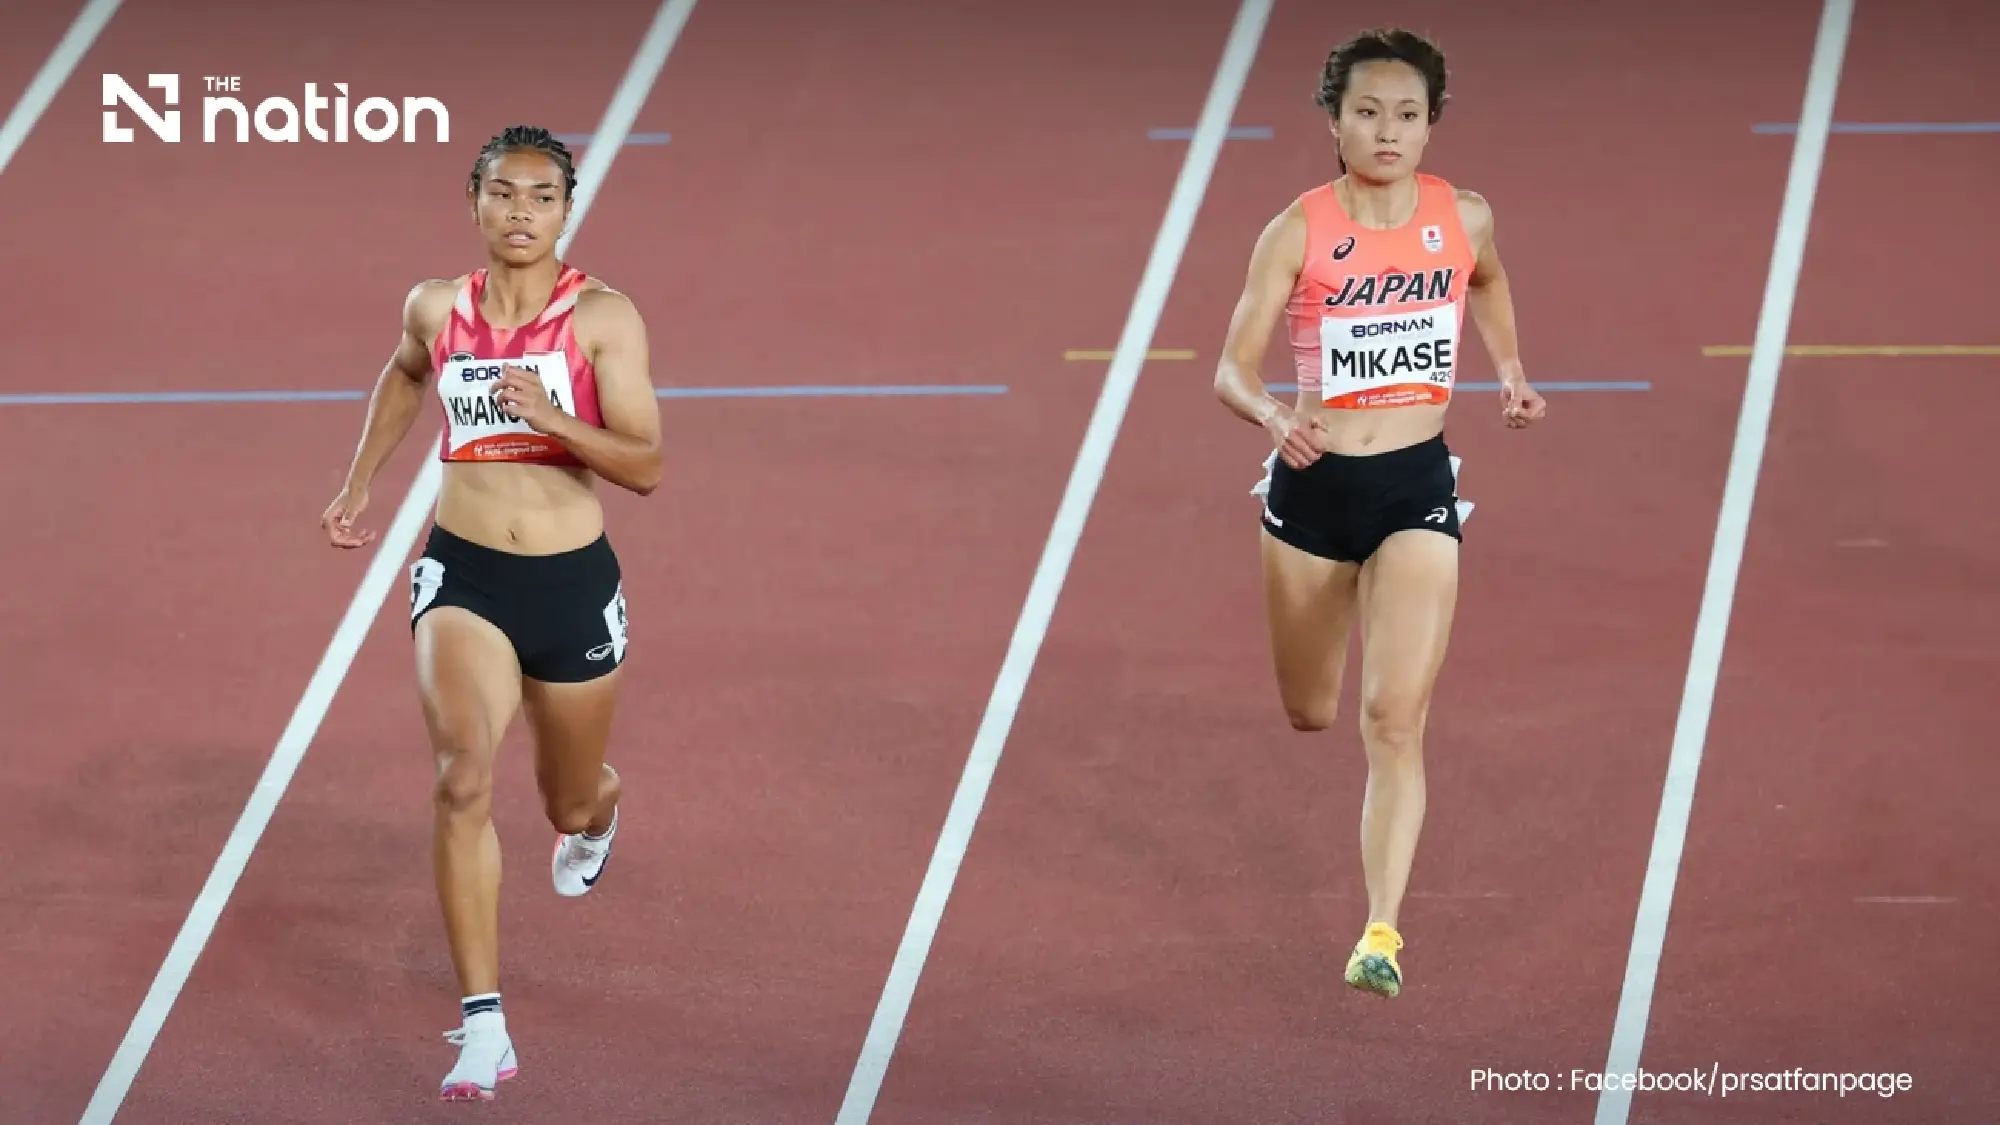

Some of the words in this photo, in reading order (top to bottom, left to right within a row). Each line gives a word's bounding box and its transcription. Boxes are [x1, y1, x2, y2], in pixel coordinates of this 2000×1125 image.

[1325, 268, 1453, 306] JAPAN
[1350, 316, 1434, 338] BORNAN
[1331, 339, 1452, 379] MIKASE
